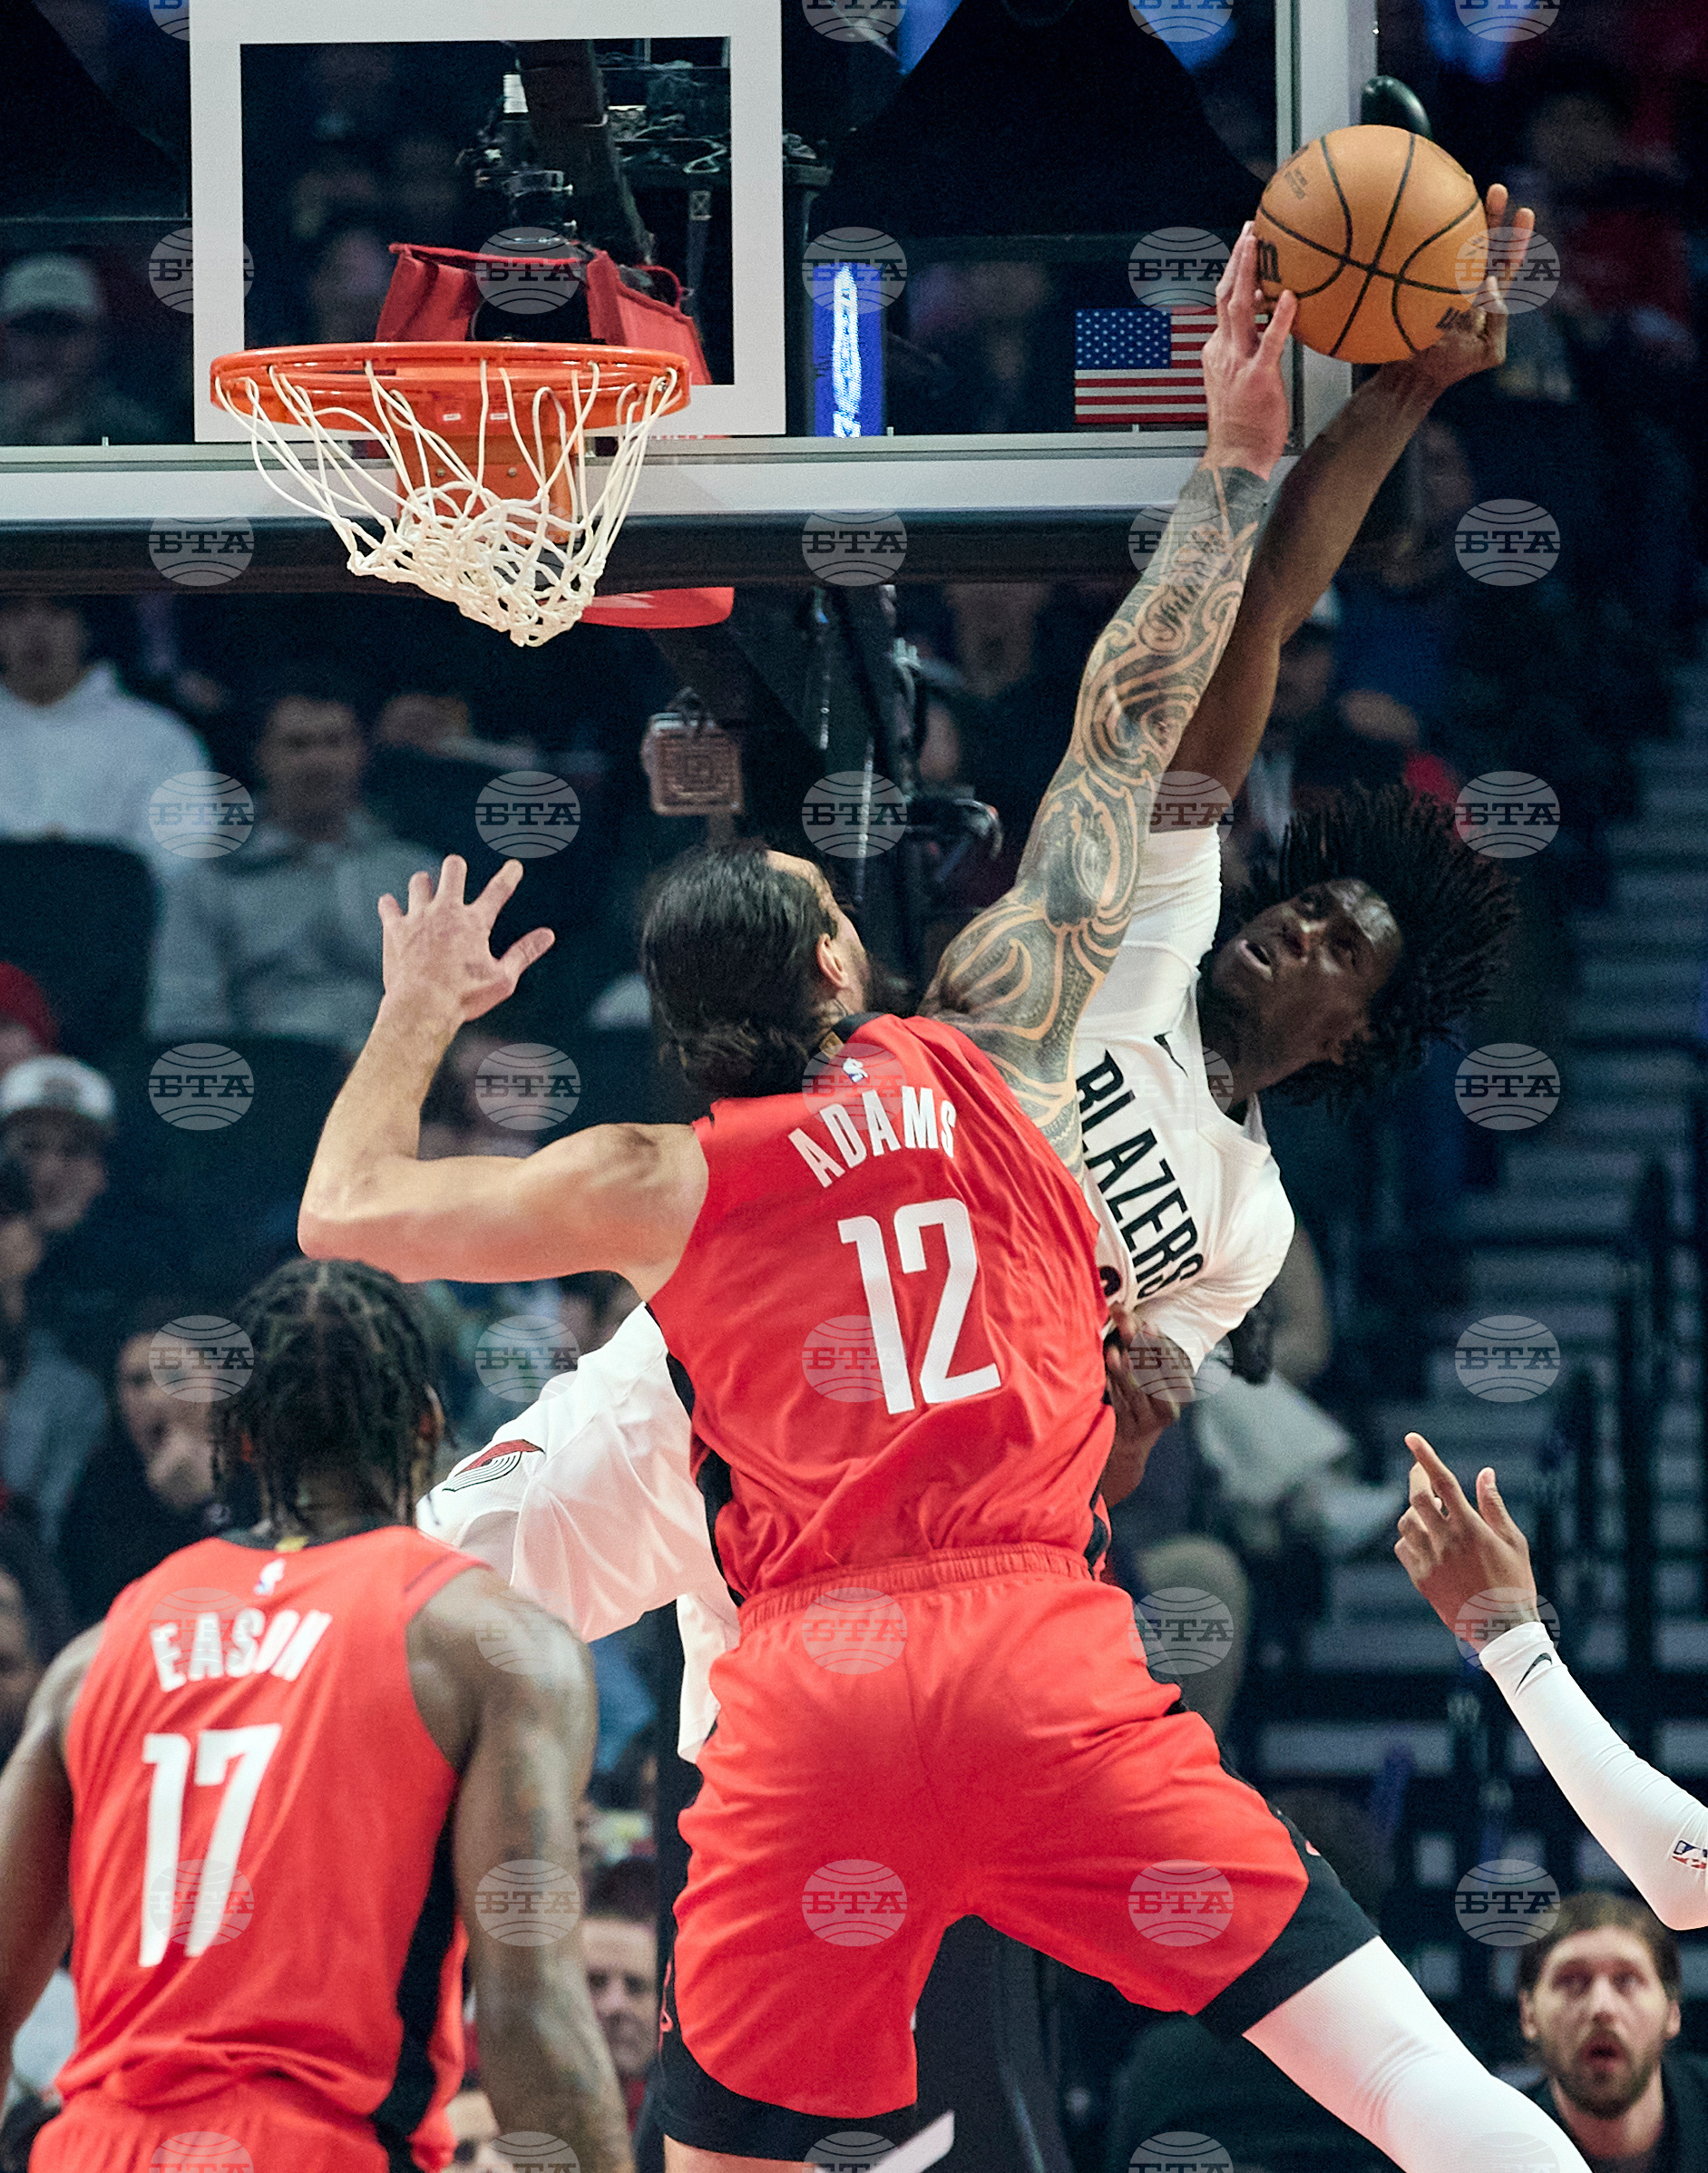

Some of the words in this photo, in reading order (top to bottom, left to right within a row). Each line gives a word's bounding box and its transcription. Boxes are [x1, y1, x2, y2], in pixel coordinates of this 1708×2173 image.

[788, 1086, 957, 1189] ADAMS
[1076, 1048, 1204, 1300] BLAZERS
[837, 1198, 1001, 1415] 12
[149, 1608, 333, 1692] EASON
[139, 1723, 282, 1968] 17
